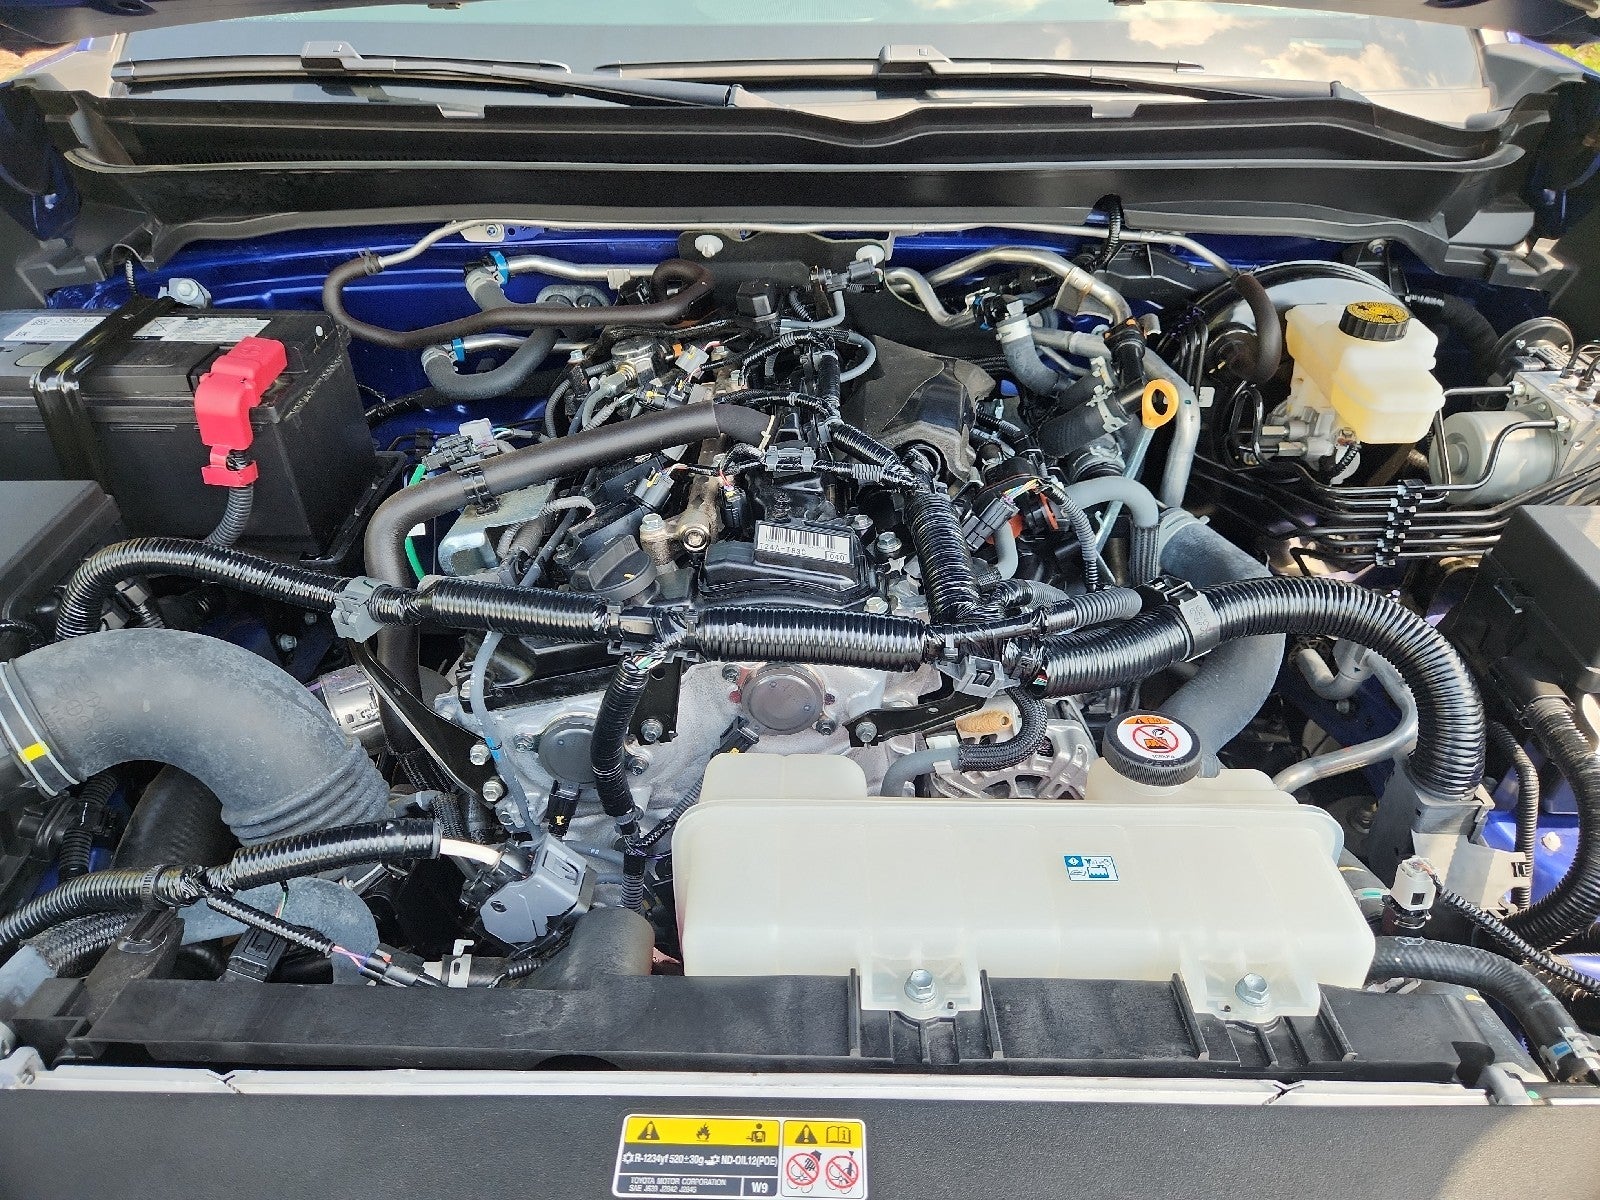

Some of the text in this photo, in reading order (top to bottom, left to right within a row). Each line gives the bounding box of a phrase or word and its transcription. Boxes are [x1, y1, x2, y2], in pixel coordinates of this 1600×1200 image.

[634, 1153, 669, 1165] R-1234yf
[669, 1154, 704, 1166] 520±30g
[630, 1176, 727, 1186] TOYOTA MOTOR CORPORATION
[628, 1184, 642, 1192] SAE
[751, 1181, 769, 1194] W9
